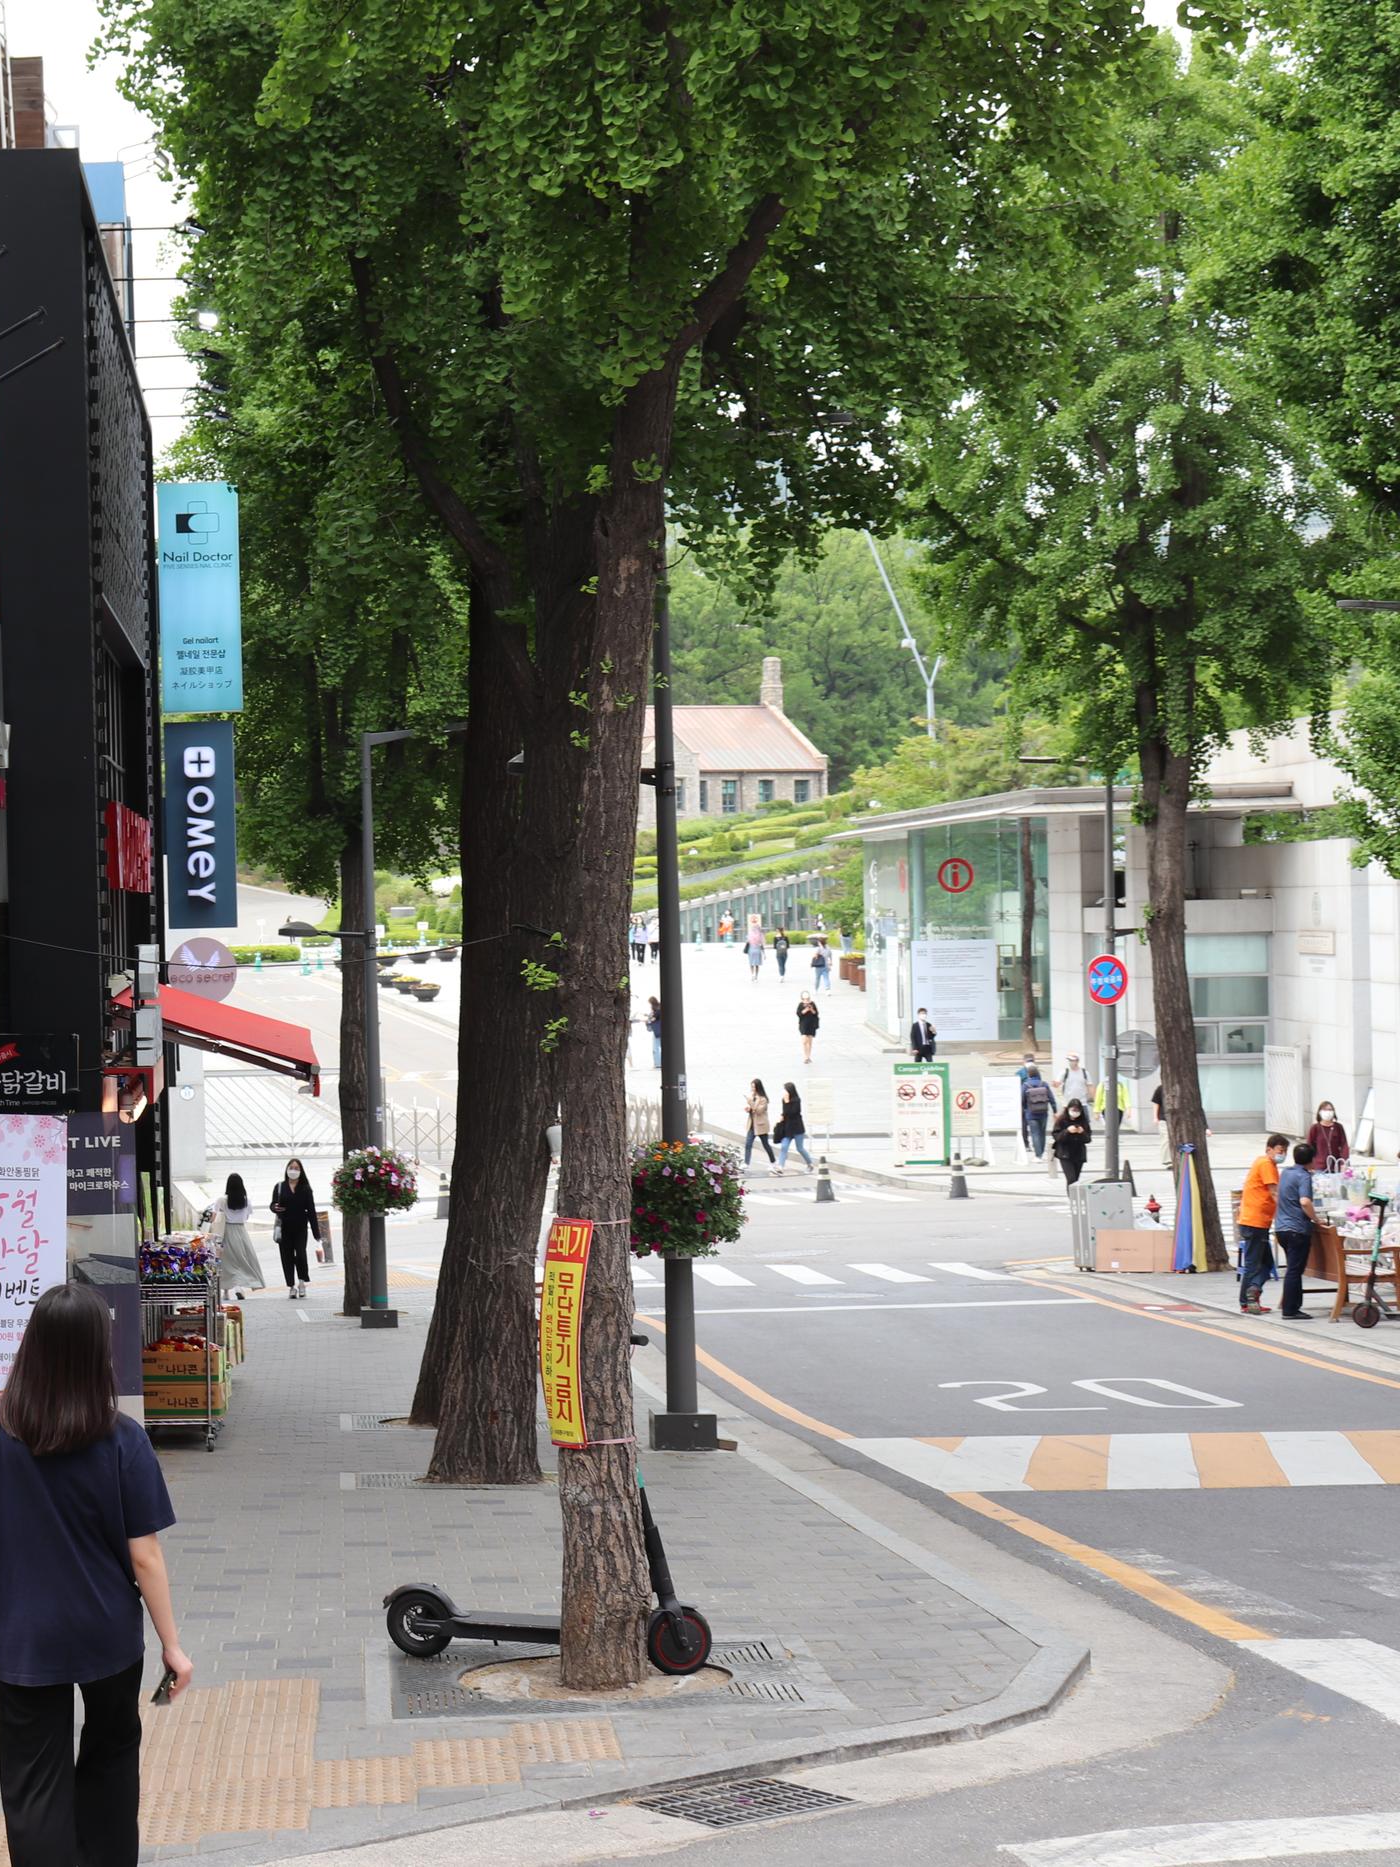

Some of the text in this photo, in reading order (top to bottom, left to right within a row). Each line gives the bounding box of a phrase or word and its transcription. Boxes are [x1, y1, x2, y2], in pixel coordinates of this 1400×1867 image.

[163, 551, 233, 562] Nail Doctor
[182, 637, 219, 645] Gel nailart
[176, 649, 226, 660] 젤네일 전문샵
[171, 680, 233, 690] ネイルショップ
[170, 972, 235, 984] eco secret
[85, 1135, 121, 1148] LIVE
[69, 1180, 130, 1192] 마이크로하우스
[547, 1226, 589, 1259] 쓰레기
[555, 1272, 575, 1424] 무단투기 금지
[936, 1377, 1245, 1412] 20
